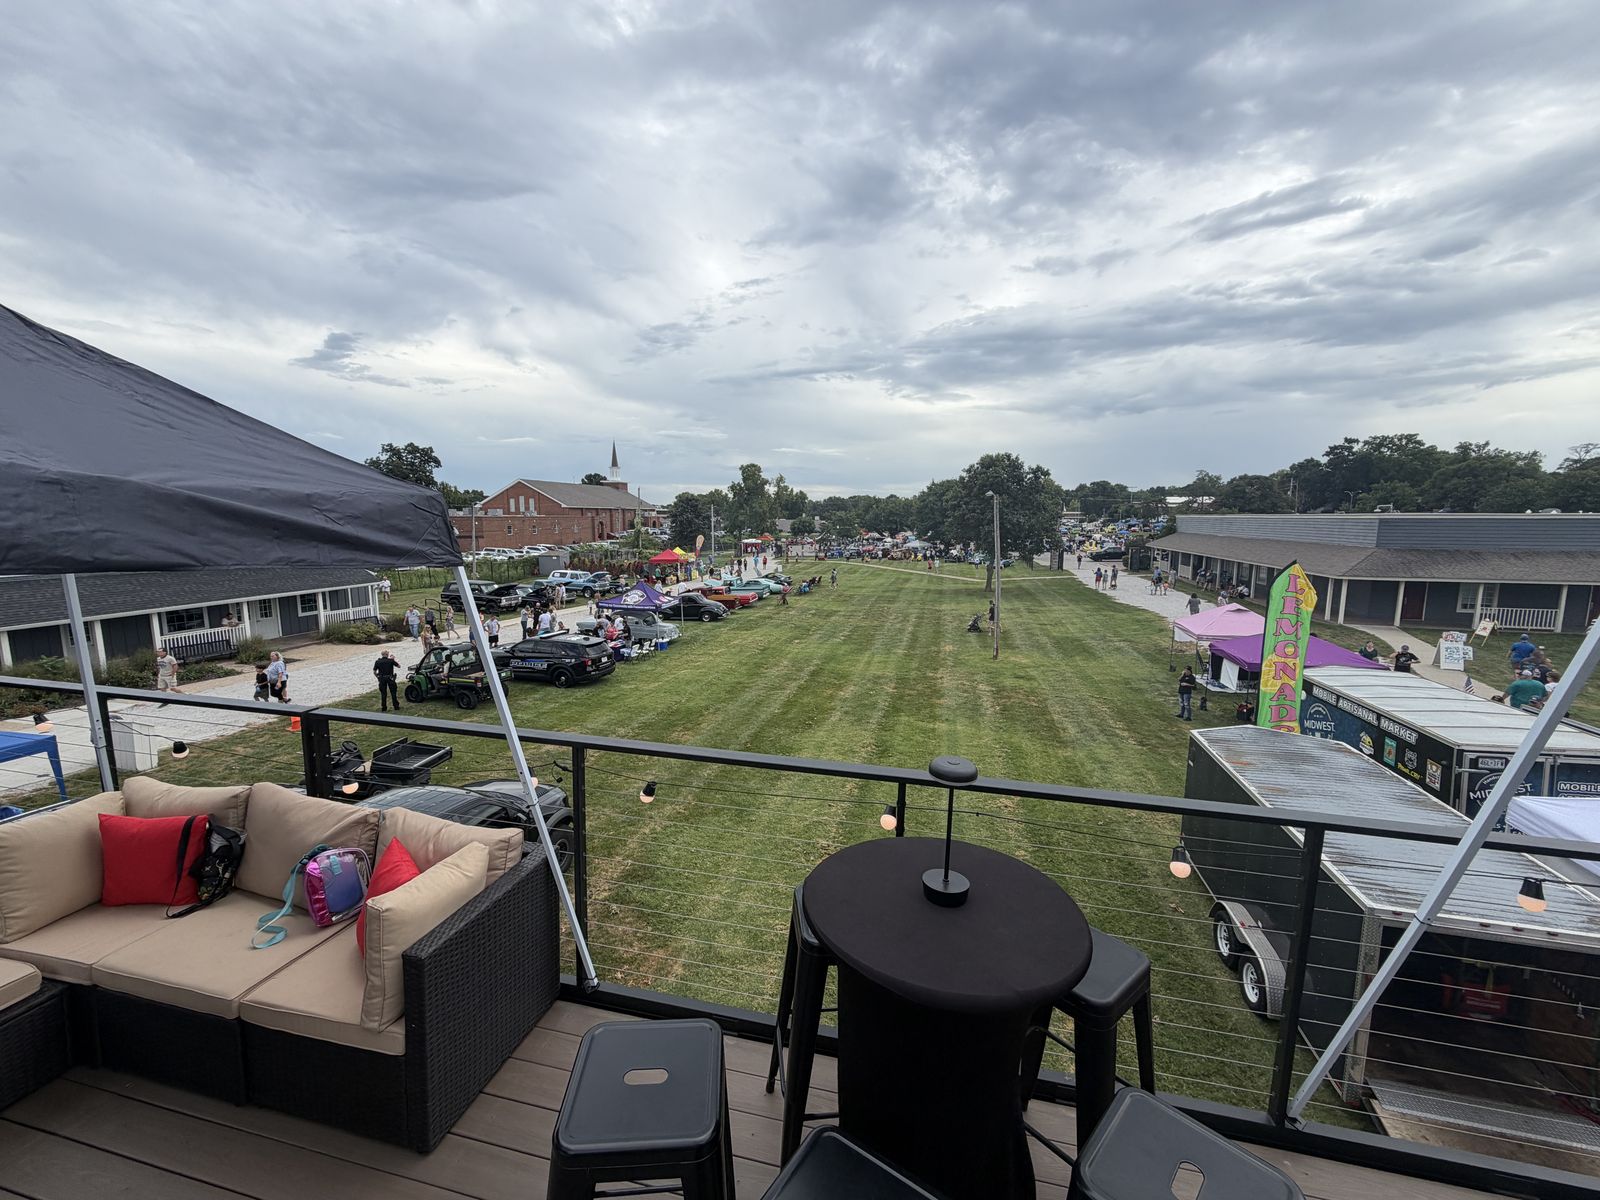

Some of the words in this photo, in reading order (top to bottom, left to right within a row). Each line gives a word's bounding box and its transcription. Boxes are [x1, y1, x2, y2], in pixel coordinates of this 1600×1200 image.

[1312, 685, 1337, 706] MOBILE
[1337, 697, 1379, 727] ARTISANAL
[1380, 716, 1419, 745] MARKET
